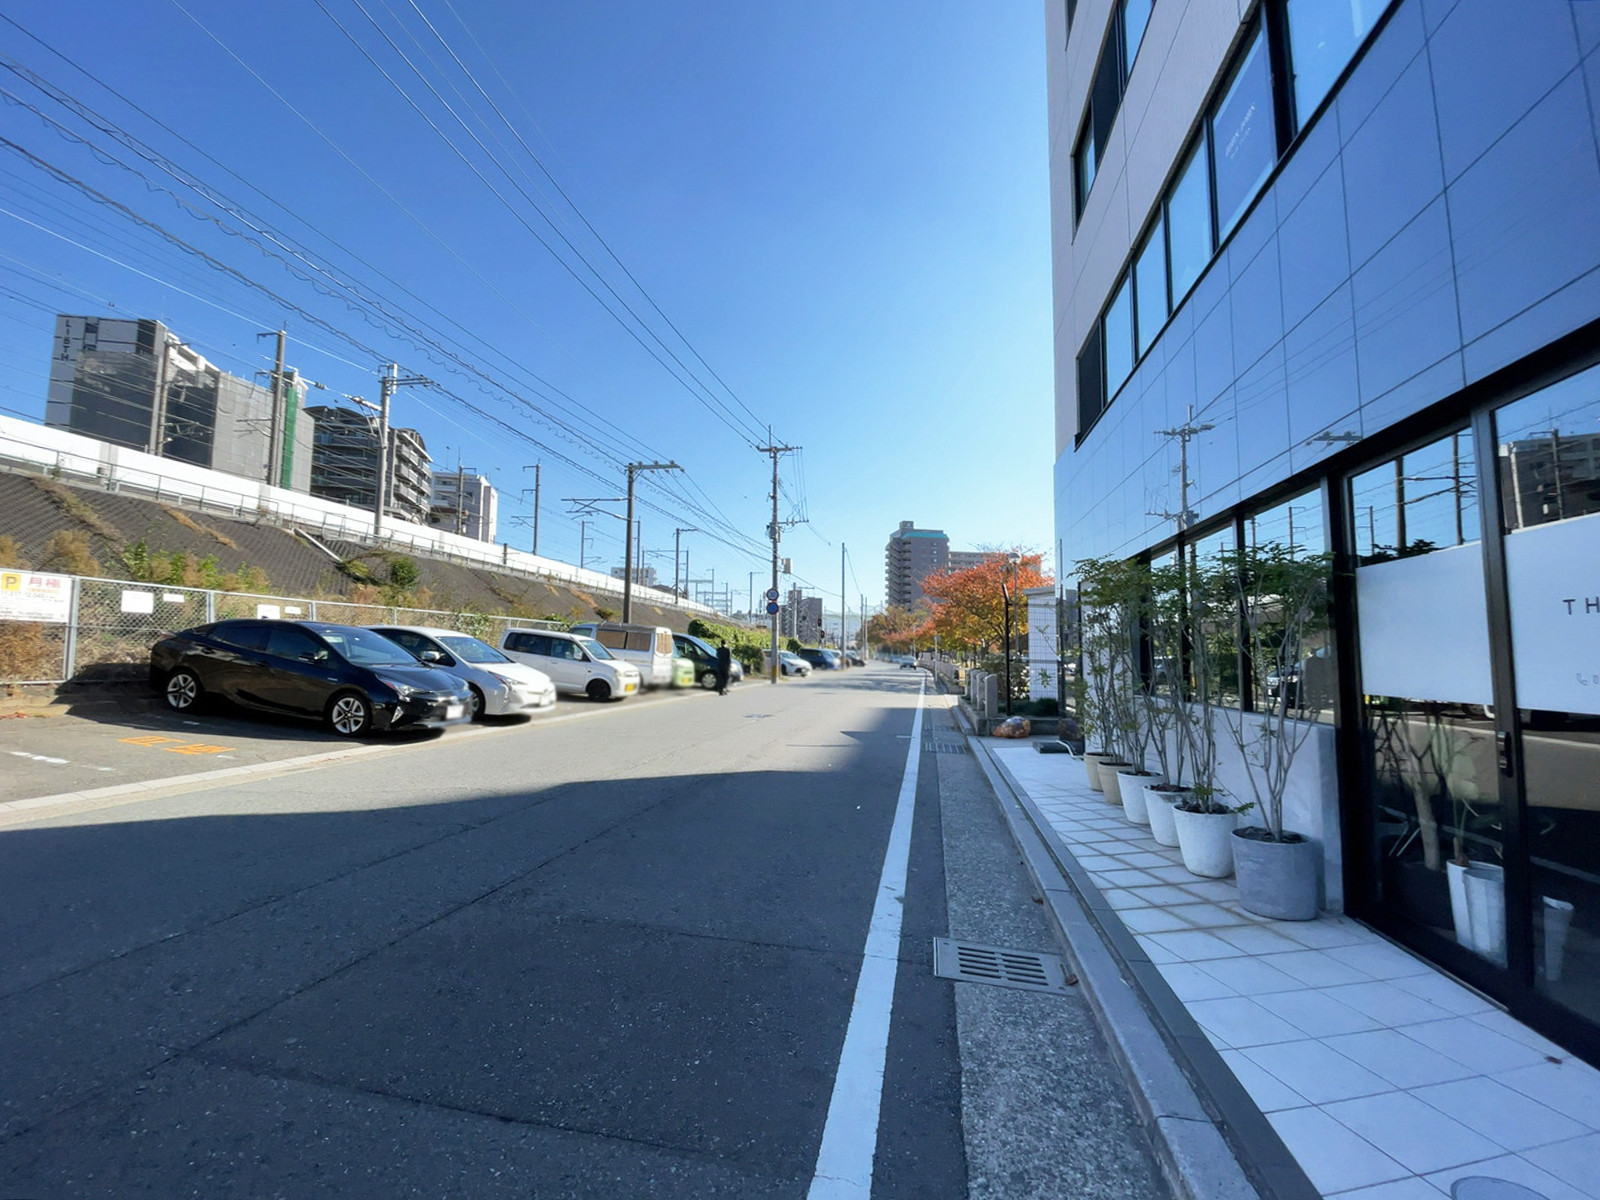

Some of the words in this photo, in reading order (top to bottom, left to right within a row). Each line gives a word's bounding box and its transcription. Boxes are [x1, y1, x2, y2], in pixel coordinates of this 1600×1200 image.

[5, 575, 18, 589] P
[28, 576, 61, 588] 月極
[1562, 596, 1600, 616] TH
